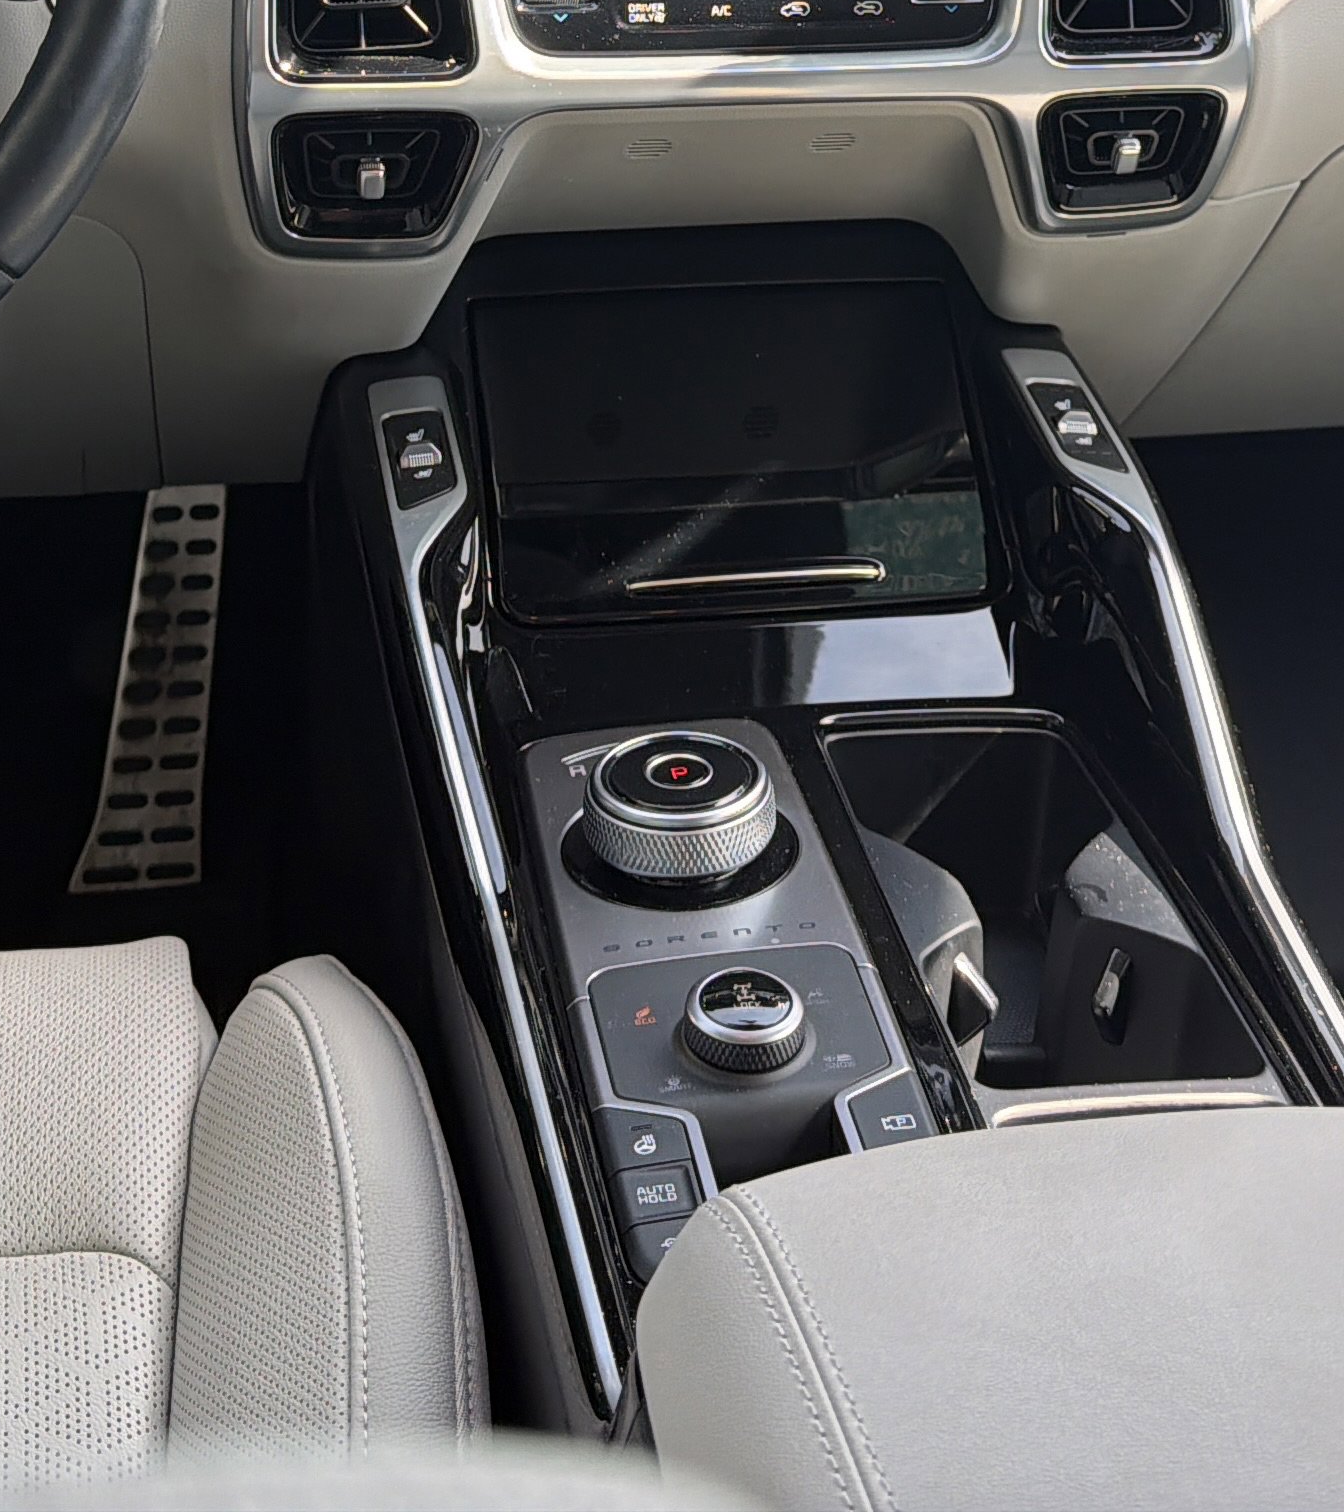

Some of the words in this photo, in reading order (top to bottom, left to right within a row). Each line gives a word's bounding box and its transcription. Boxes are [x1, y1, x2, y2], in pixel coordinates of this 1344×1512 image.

[628, 3, 665, 13] DRIVER
[711, 5, 732, 17] A/C
[628, 13, 655, 24] ONLY
[568, 764, 587, 778] R
[670, 766, 688, 780] P
[634, 1016, 657, 1026] ECO
[636, 1183, 675, 1196] AUTO
[638, 1192, 677, 1205] HOLD
